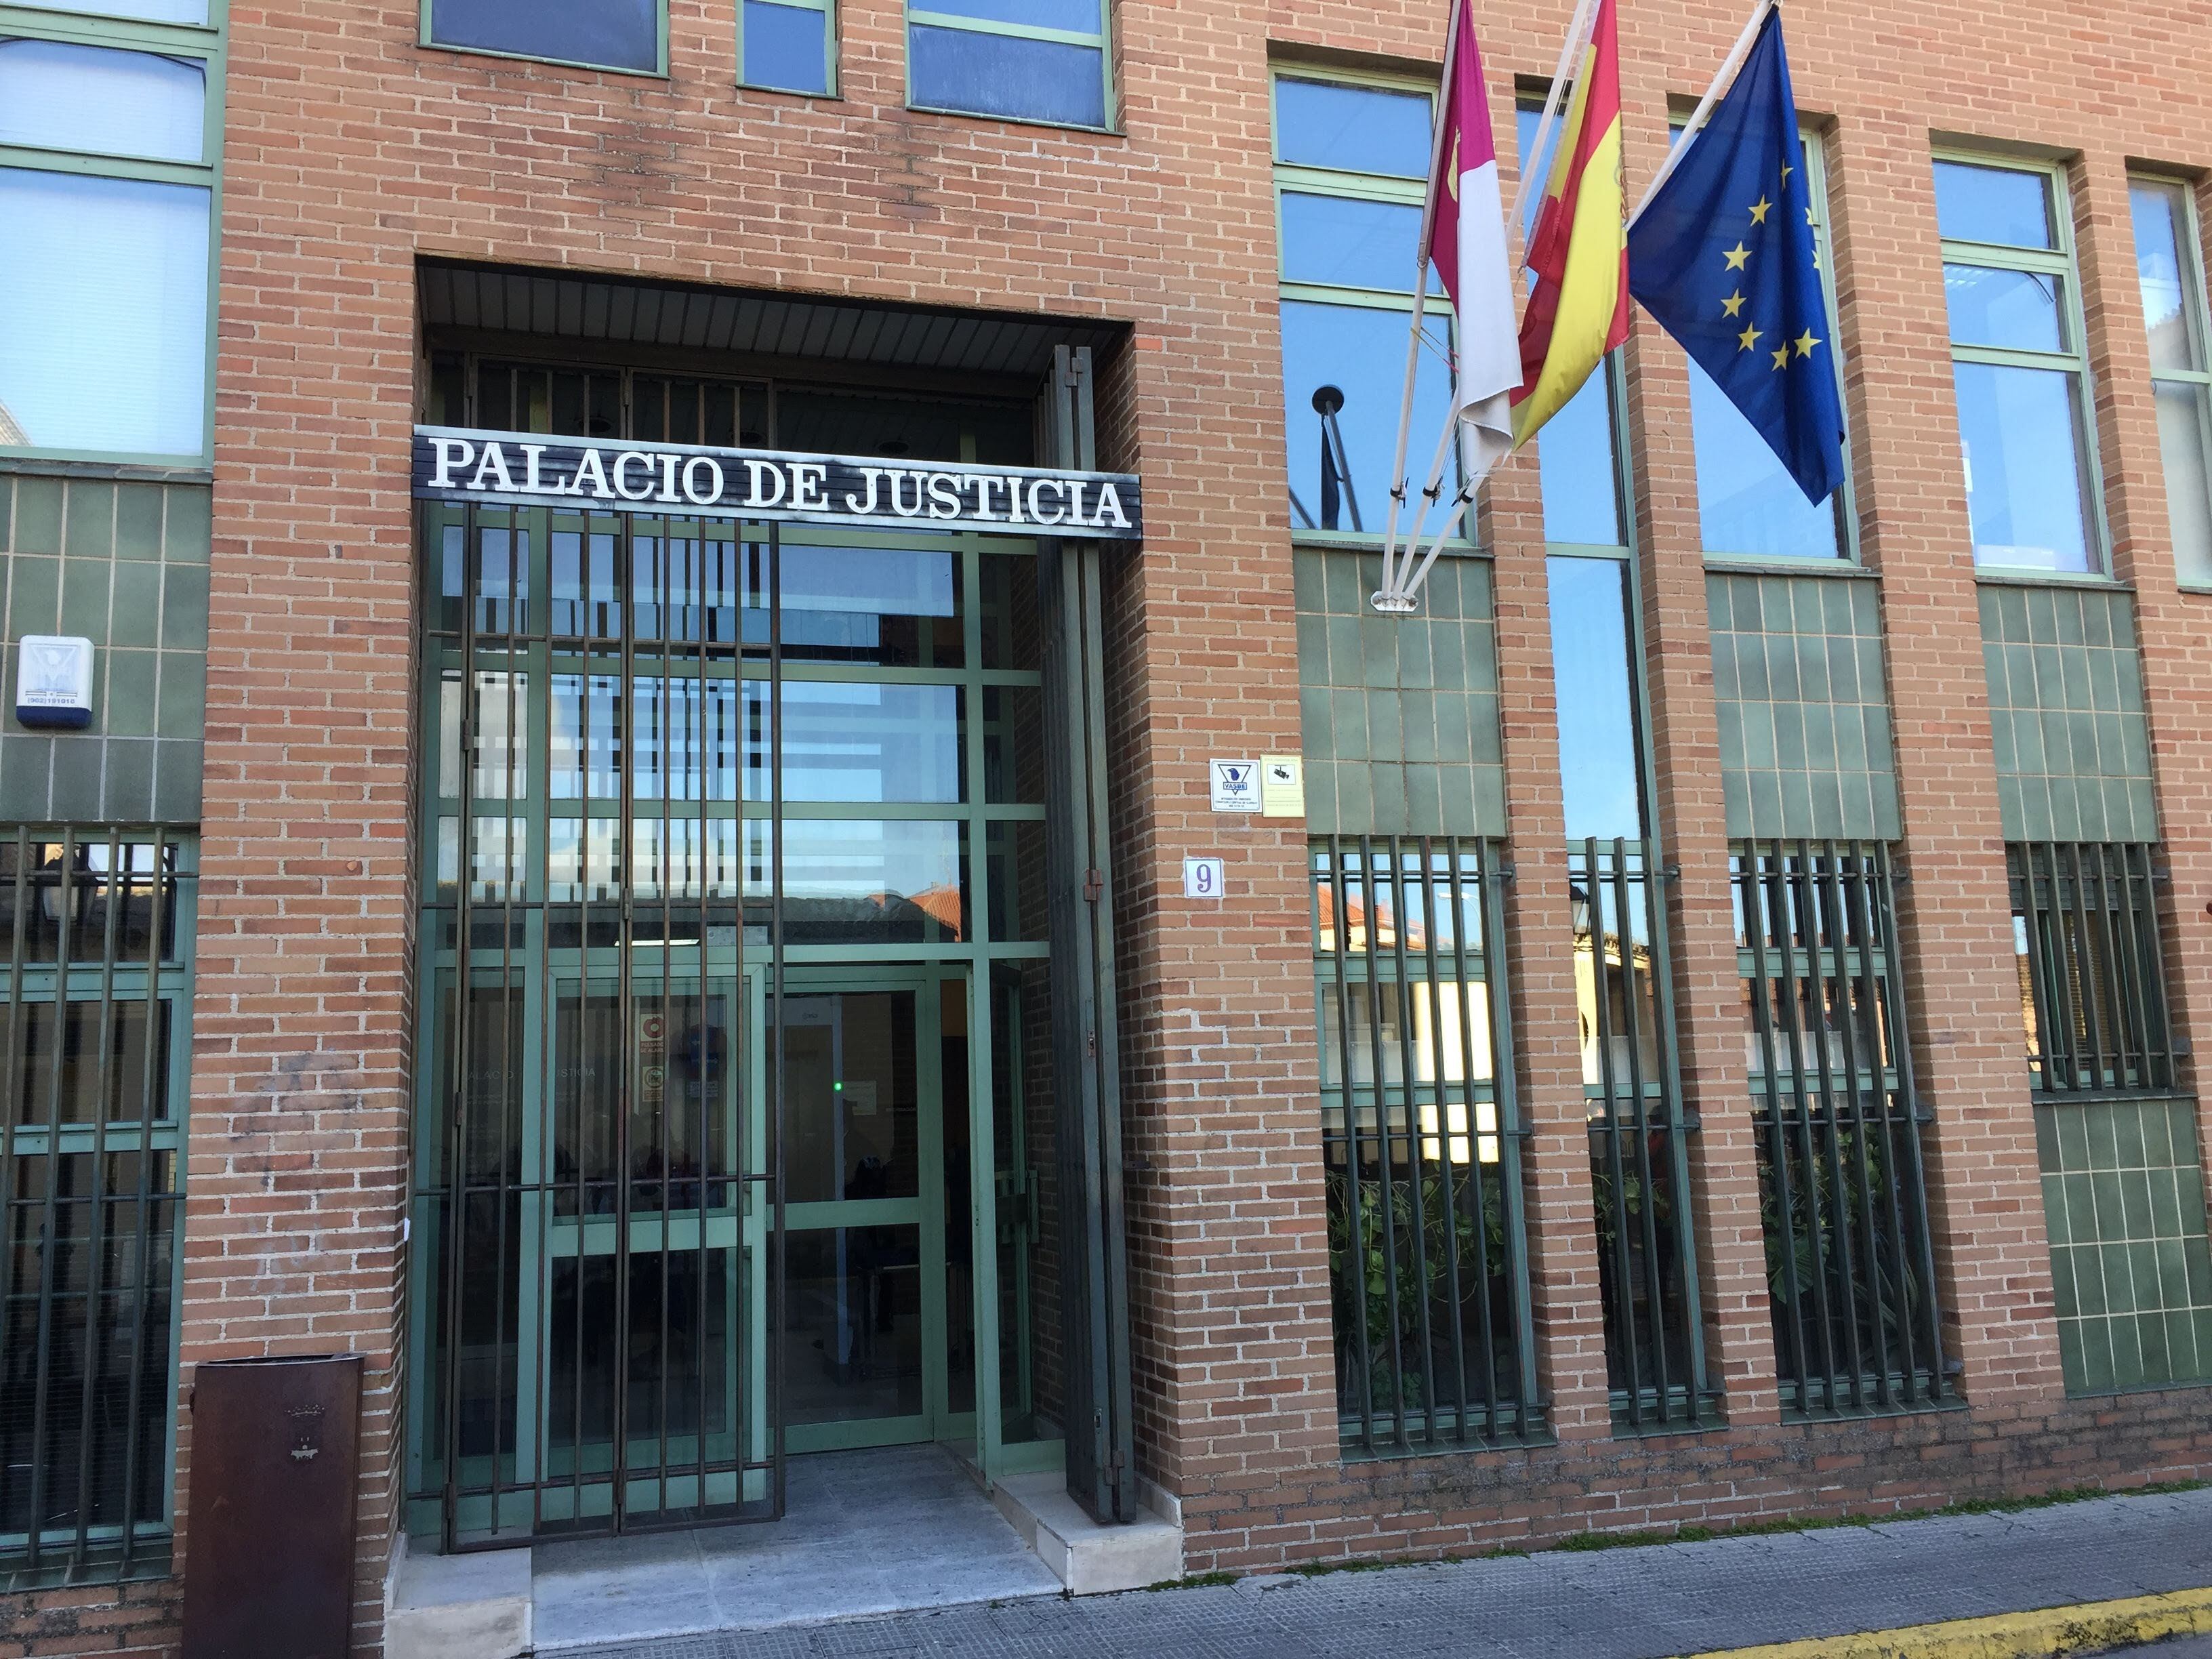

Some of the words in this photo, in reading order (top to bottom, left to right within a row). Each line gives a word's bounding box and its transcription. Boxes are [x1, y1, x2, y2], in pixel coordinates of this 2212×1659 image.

[428, 437, 724, 504] PALACIO
[743, 459, 828, 511] DE
[846, 468, 1132, 528] JUSTICIA
[1196, 864, 1211, 893] 9
